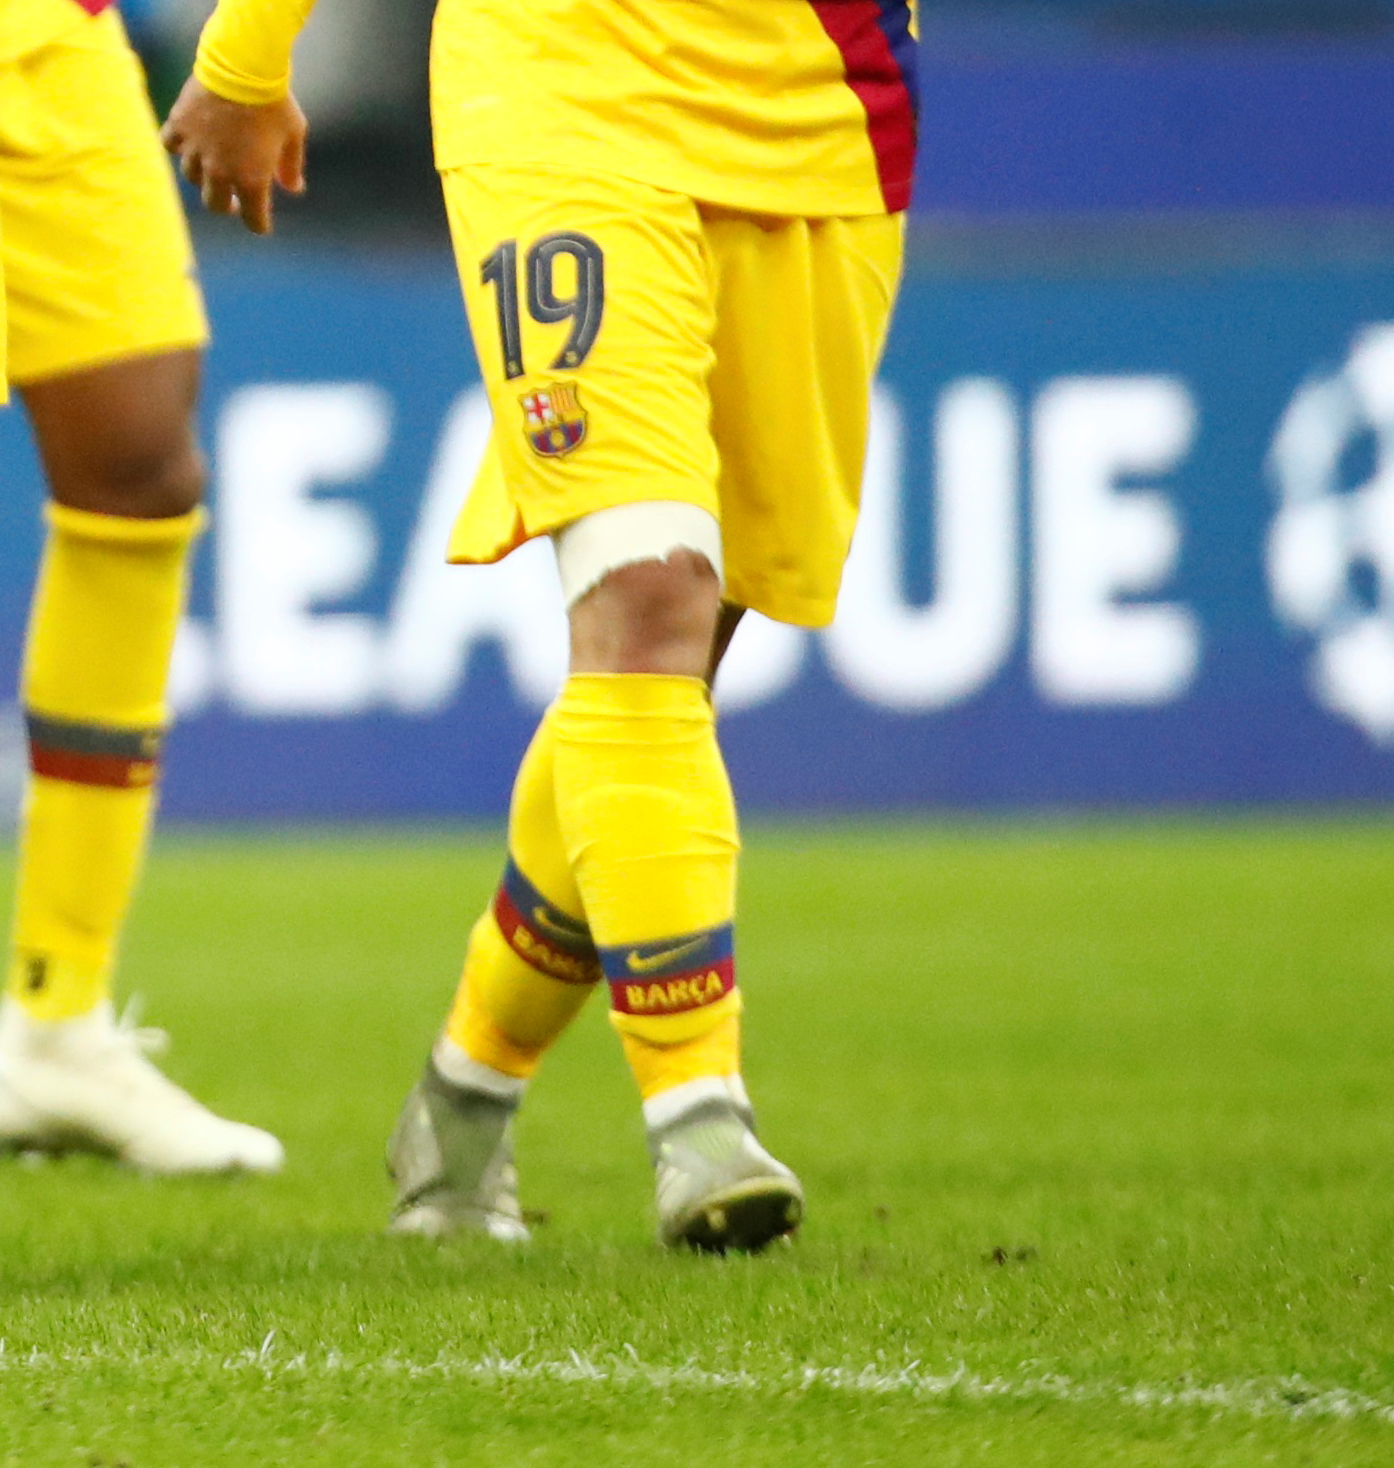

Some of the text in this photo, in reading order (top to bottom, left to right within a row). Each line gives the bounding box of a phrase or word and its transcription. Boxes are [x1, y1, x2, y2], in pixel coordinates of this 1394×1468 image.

[479, 229, 606, 381] 19
[161, 375, 1199, 714] EAUE
[625, 969, 724, 1009] BARÇA
